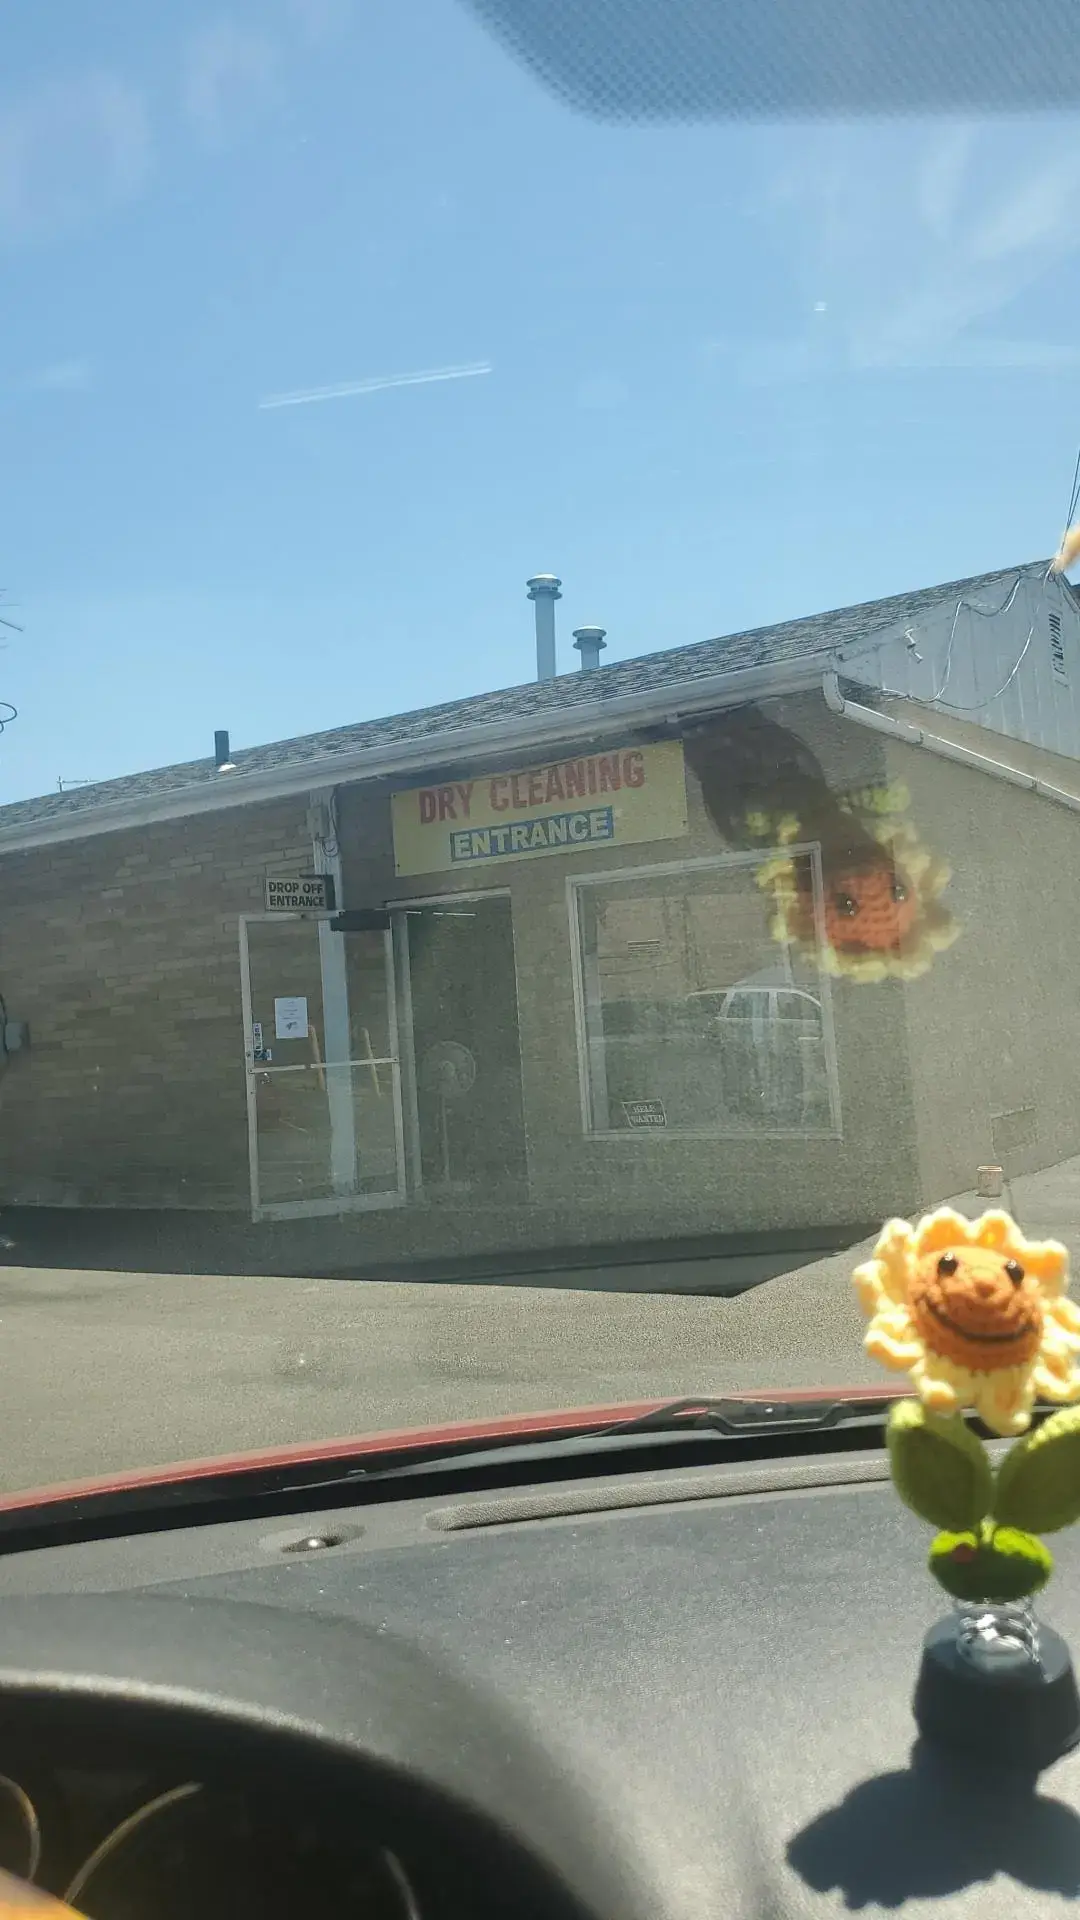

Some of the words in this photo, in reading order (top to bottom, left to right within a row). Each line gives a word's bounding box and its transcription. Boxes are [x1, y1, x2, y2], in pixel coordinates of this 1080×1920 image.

[418, 782, 474, 824] DRY
[489, 751, 646, 811] CLEANING
[453, 810, 610, 859] ENTRANCE
[268, 881, 299, 893] DROP
[302, 883, 324, 894] OFF
[269, 895, 325, 907] ENTRANCE
